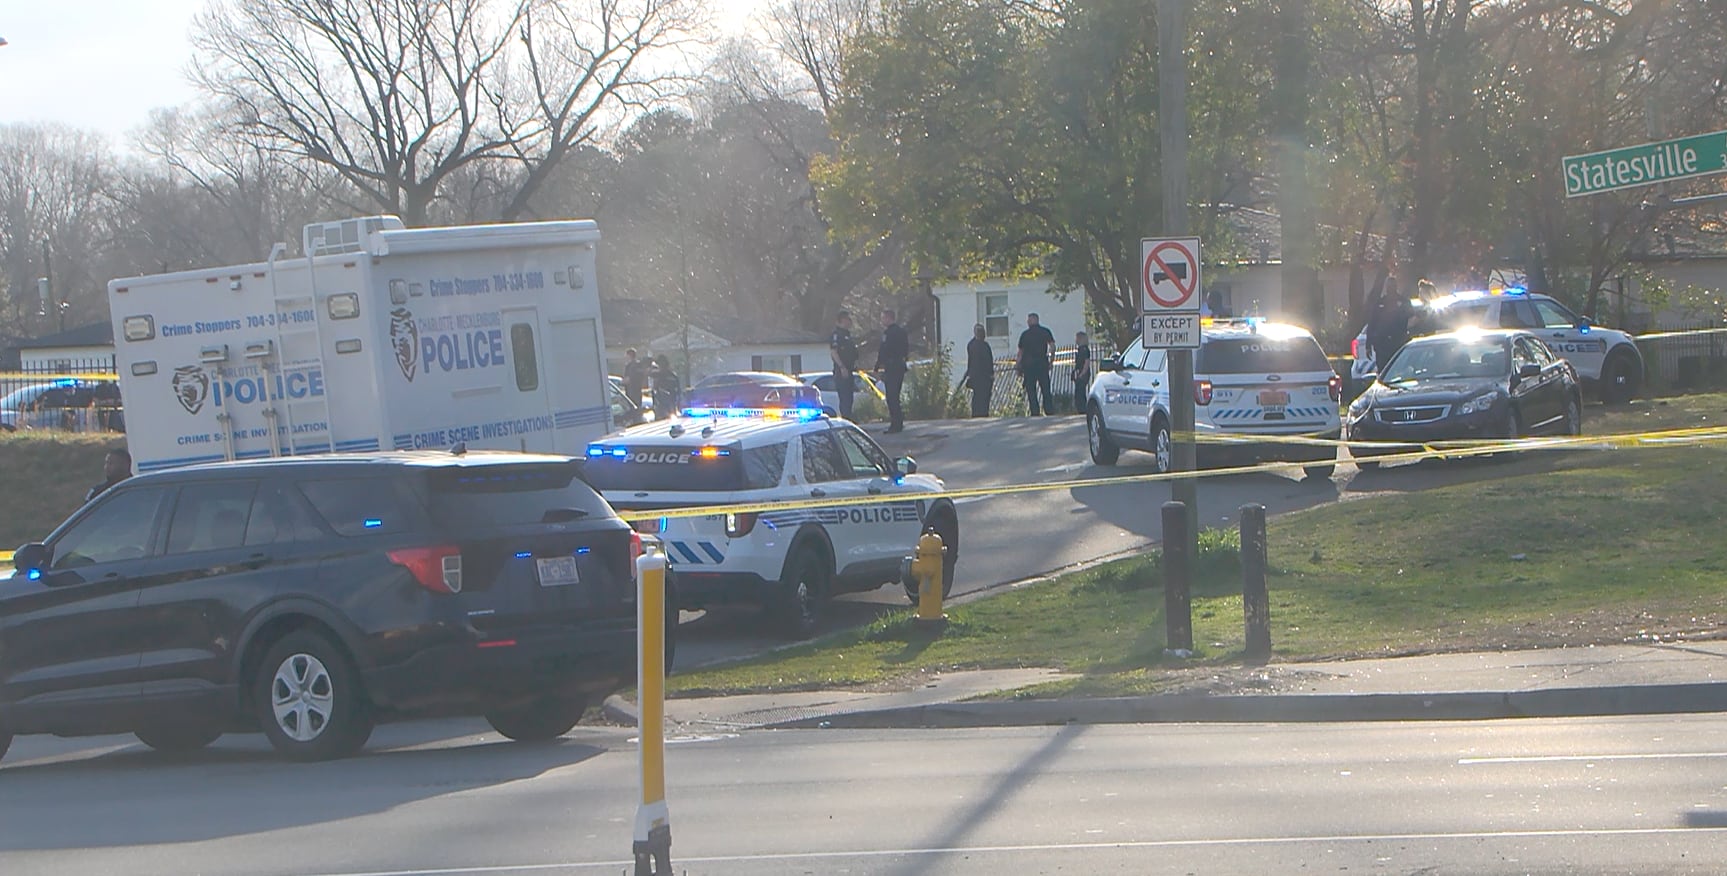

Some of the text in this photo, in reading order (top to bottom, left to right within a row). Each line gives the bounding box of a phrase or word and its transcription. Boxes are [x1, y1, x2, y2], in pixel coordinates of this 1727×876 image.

[1567, 144, 1697, 192] Statesville
[430, 279, 454, 297] Crime
[162, 323, 193, 337] Crime
[195, 318, 242, 334] Stoppers
[1151, 317, 1192, 329] EXCEPT
[1154, 332, 1189, 344] BY PERMIT
[421, 329, 505, 374] POLICE
[1241, 343, 1291, 353] POLICE
[177, 433, 211, 445] CRIME
[414, 415, 554, 449] CRIME SCENE INVESTIGATIONS
[623, 451, 691, 464] POLICE
[837, 507, 902, 524] POLICE
